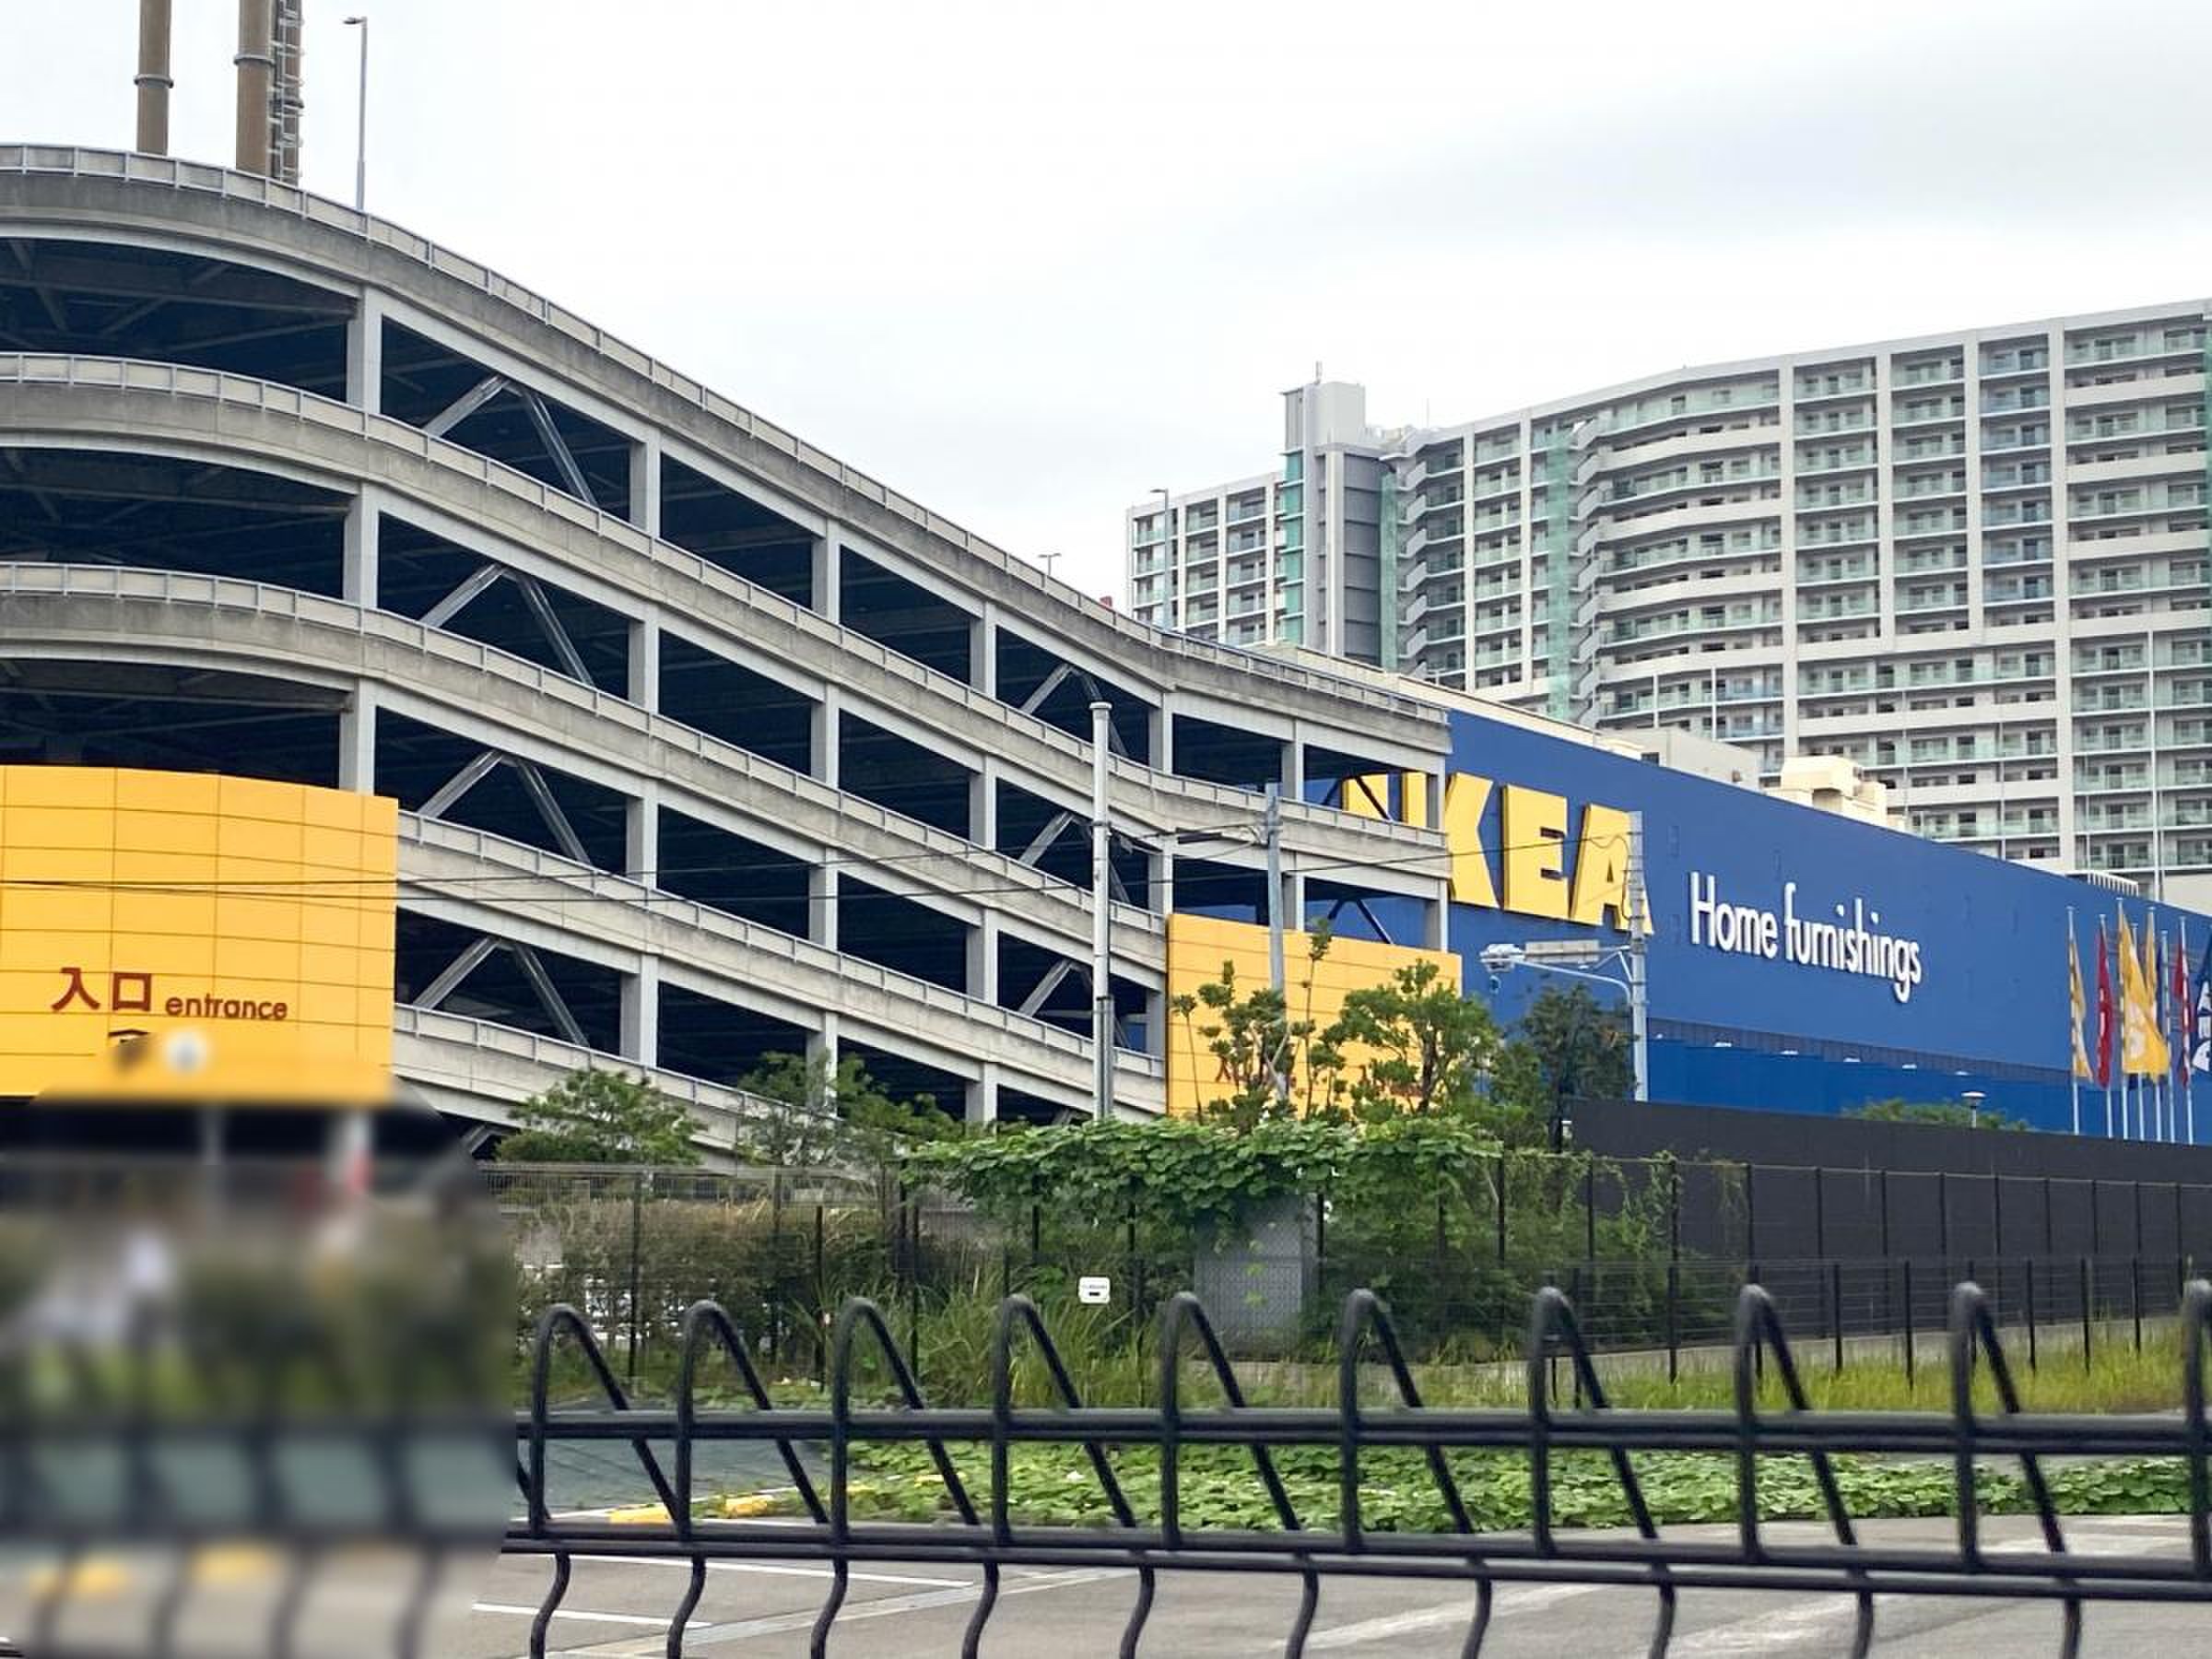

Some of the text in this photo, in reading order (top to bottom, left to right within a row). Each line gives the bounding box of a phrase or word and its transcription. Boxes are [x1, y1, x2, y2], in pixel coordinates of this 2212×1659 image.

[1689, 871, 1922, 1003] Home furnishings
[52, 968, 152, 1011] 入口
[165, 993, 288, 1020] entrance
